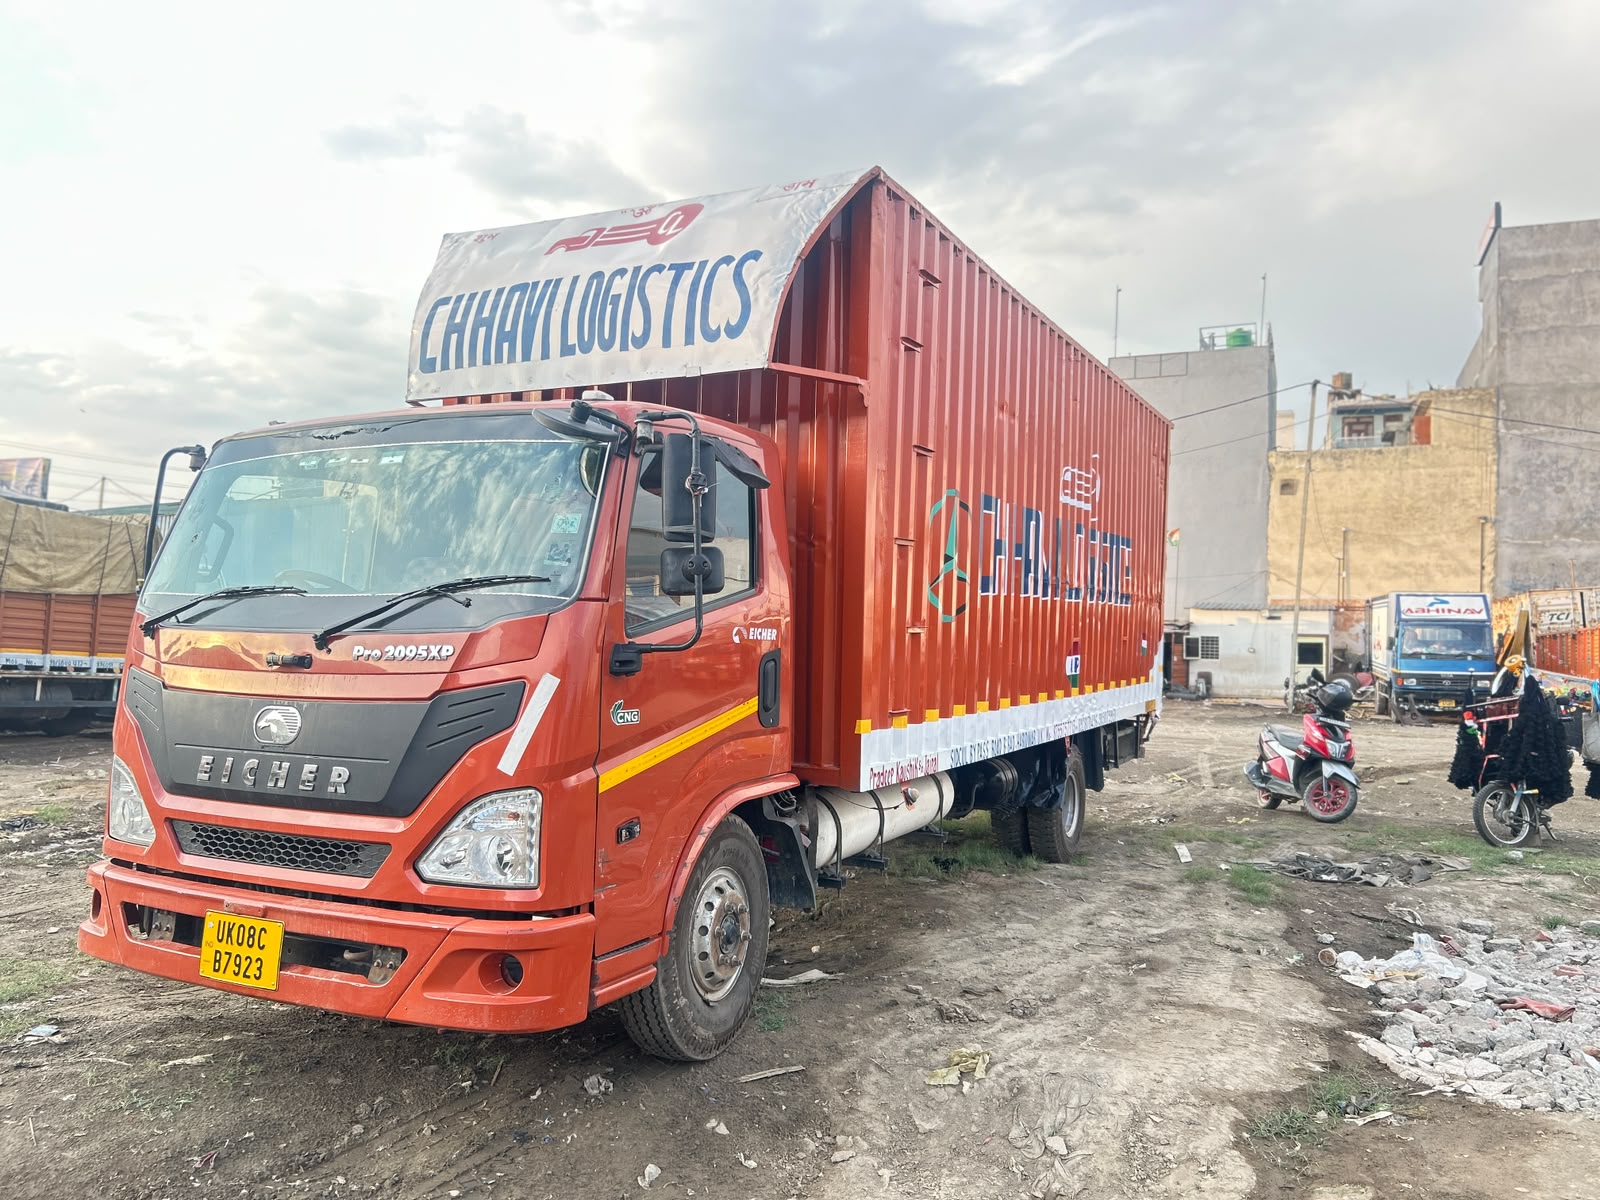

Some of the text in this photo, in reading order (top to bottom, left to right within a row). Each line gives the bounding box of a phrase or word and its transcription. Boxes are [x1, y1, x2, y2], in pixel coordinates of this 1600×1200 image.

[418, 249, 764, 375] CHHAVI LOGISTICS
[1405, 607, 1484, 615] ABHINAV
[1547, 612, 1571, 622] TCI
[748, 627, 777, 641] EICHER
[352, 644, 454, 661] Pro 2095XP
[617, 711, 639, 723] CNG
[197, 755, 350, 794] EICHER
[216, 919, 267, 951] UK08C
[212, 949, 264, 981] B7923
